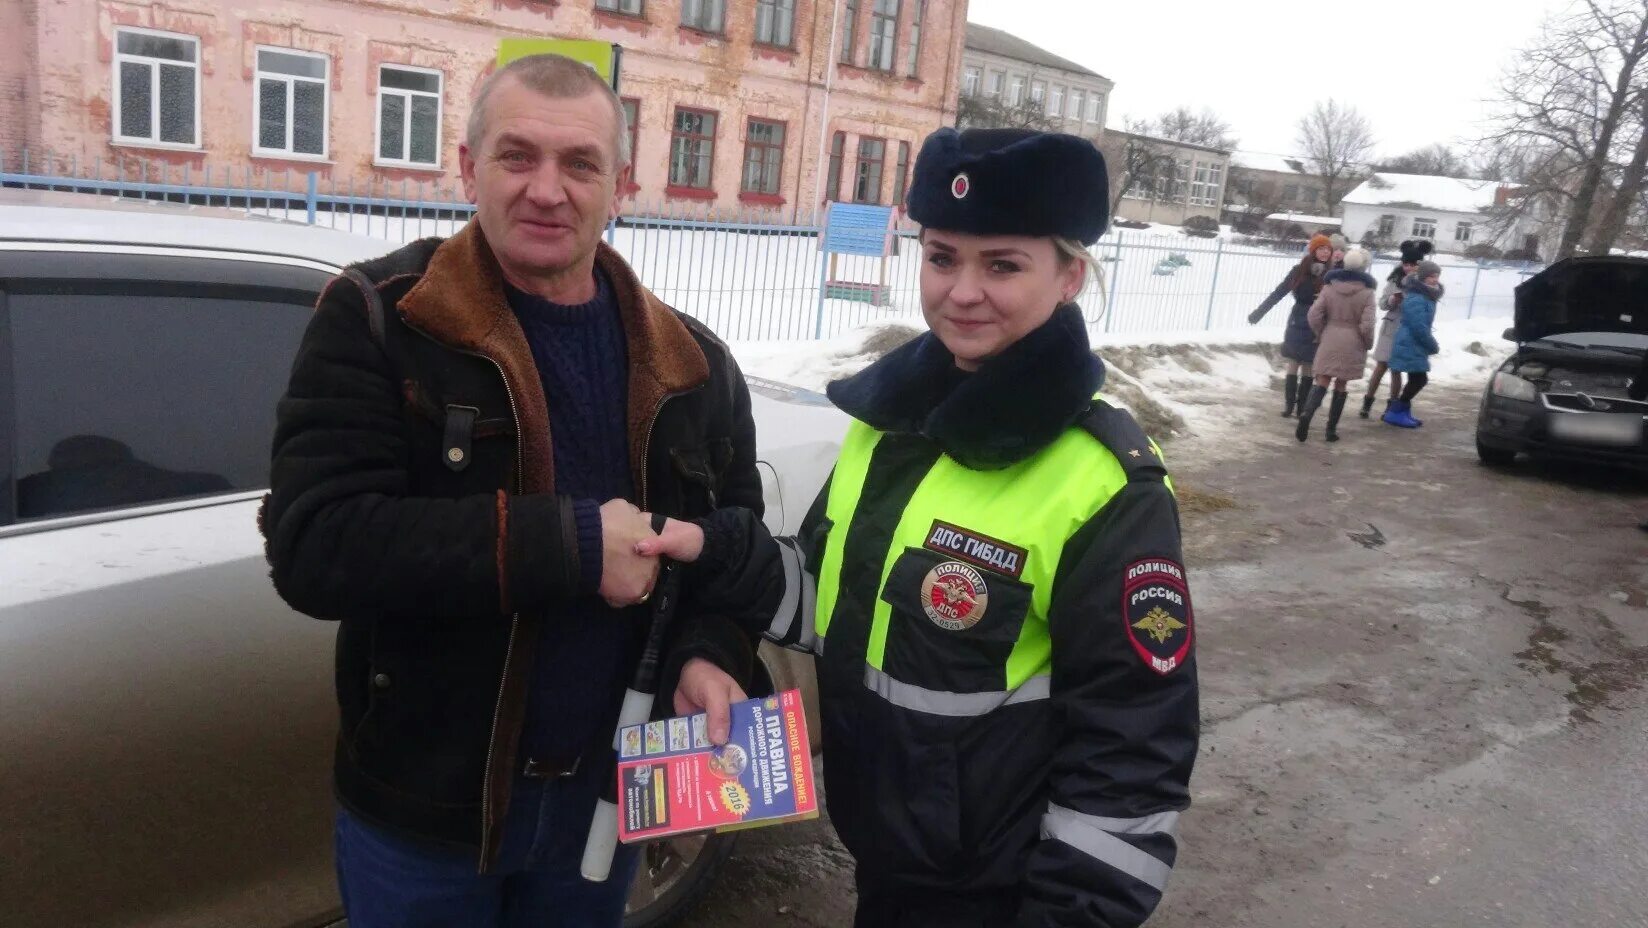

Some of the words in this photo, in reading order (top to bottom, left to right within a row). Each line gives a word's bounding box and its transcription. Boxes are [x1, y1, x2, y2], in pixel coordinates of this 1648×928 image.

[930, 528, 964, 549] ДПС
[964, 539, 1018, 572] ГИБДД
[937, 564, 984, 594] ПОЛИЦИЯ
[1129, 562, 1181, 579] ПОЛИЦИЯ
[937, 603, 958, 618] ДПС
[1131, 587, 1182, 605] РОССИЯ
[1152, 656, 1176, 672] МВД
[752, 706, 766, 756] ДОРОЖНОГО
[786, 711, 800, 751] ОПАСНОЕ
[765, 715, 788, 794] ПРАВИЛА
[758, 759, 772, 804] ДВИЖЕНИЯ
[792, 754, 806, 804] ВОЖДЕНИЕ!
[725, 786, 743, 809] 2016
